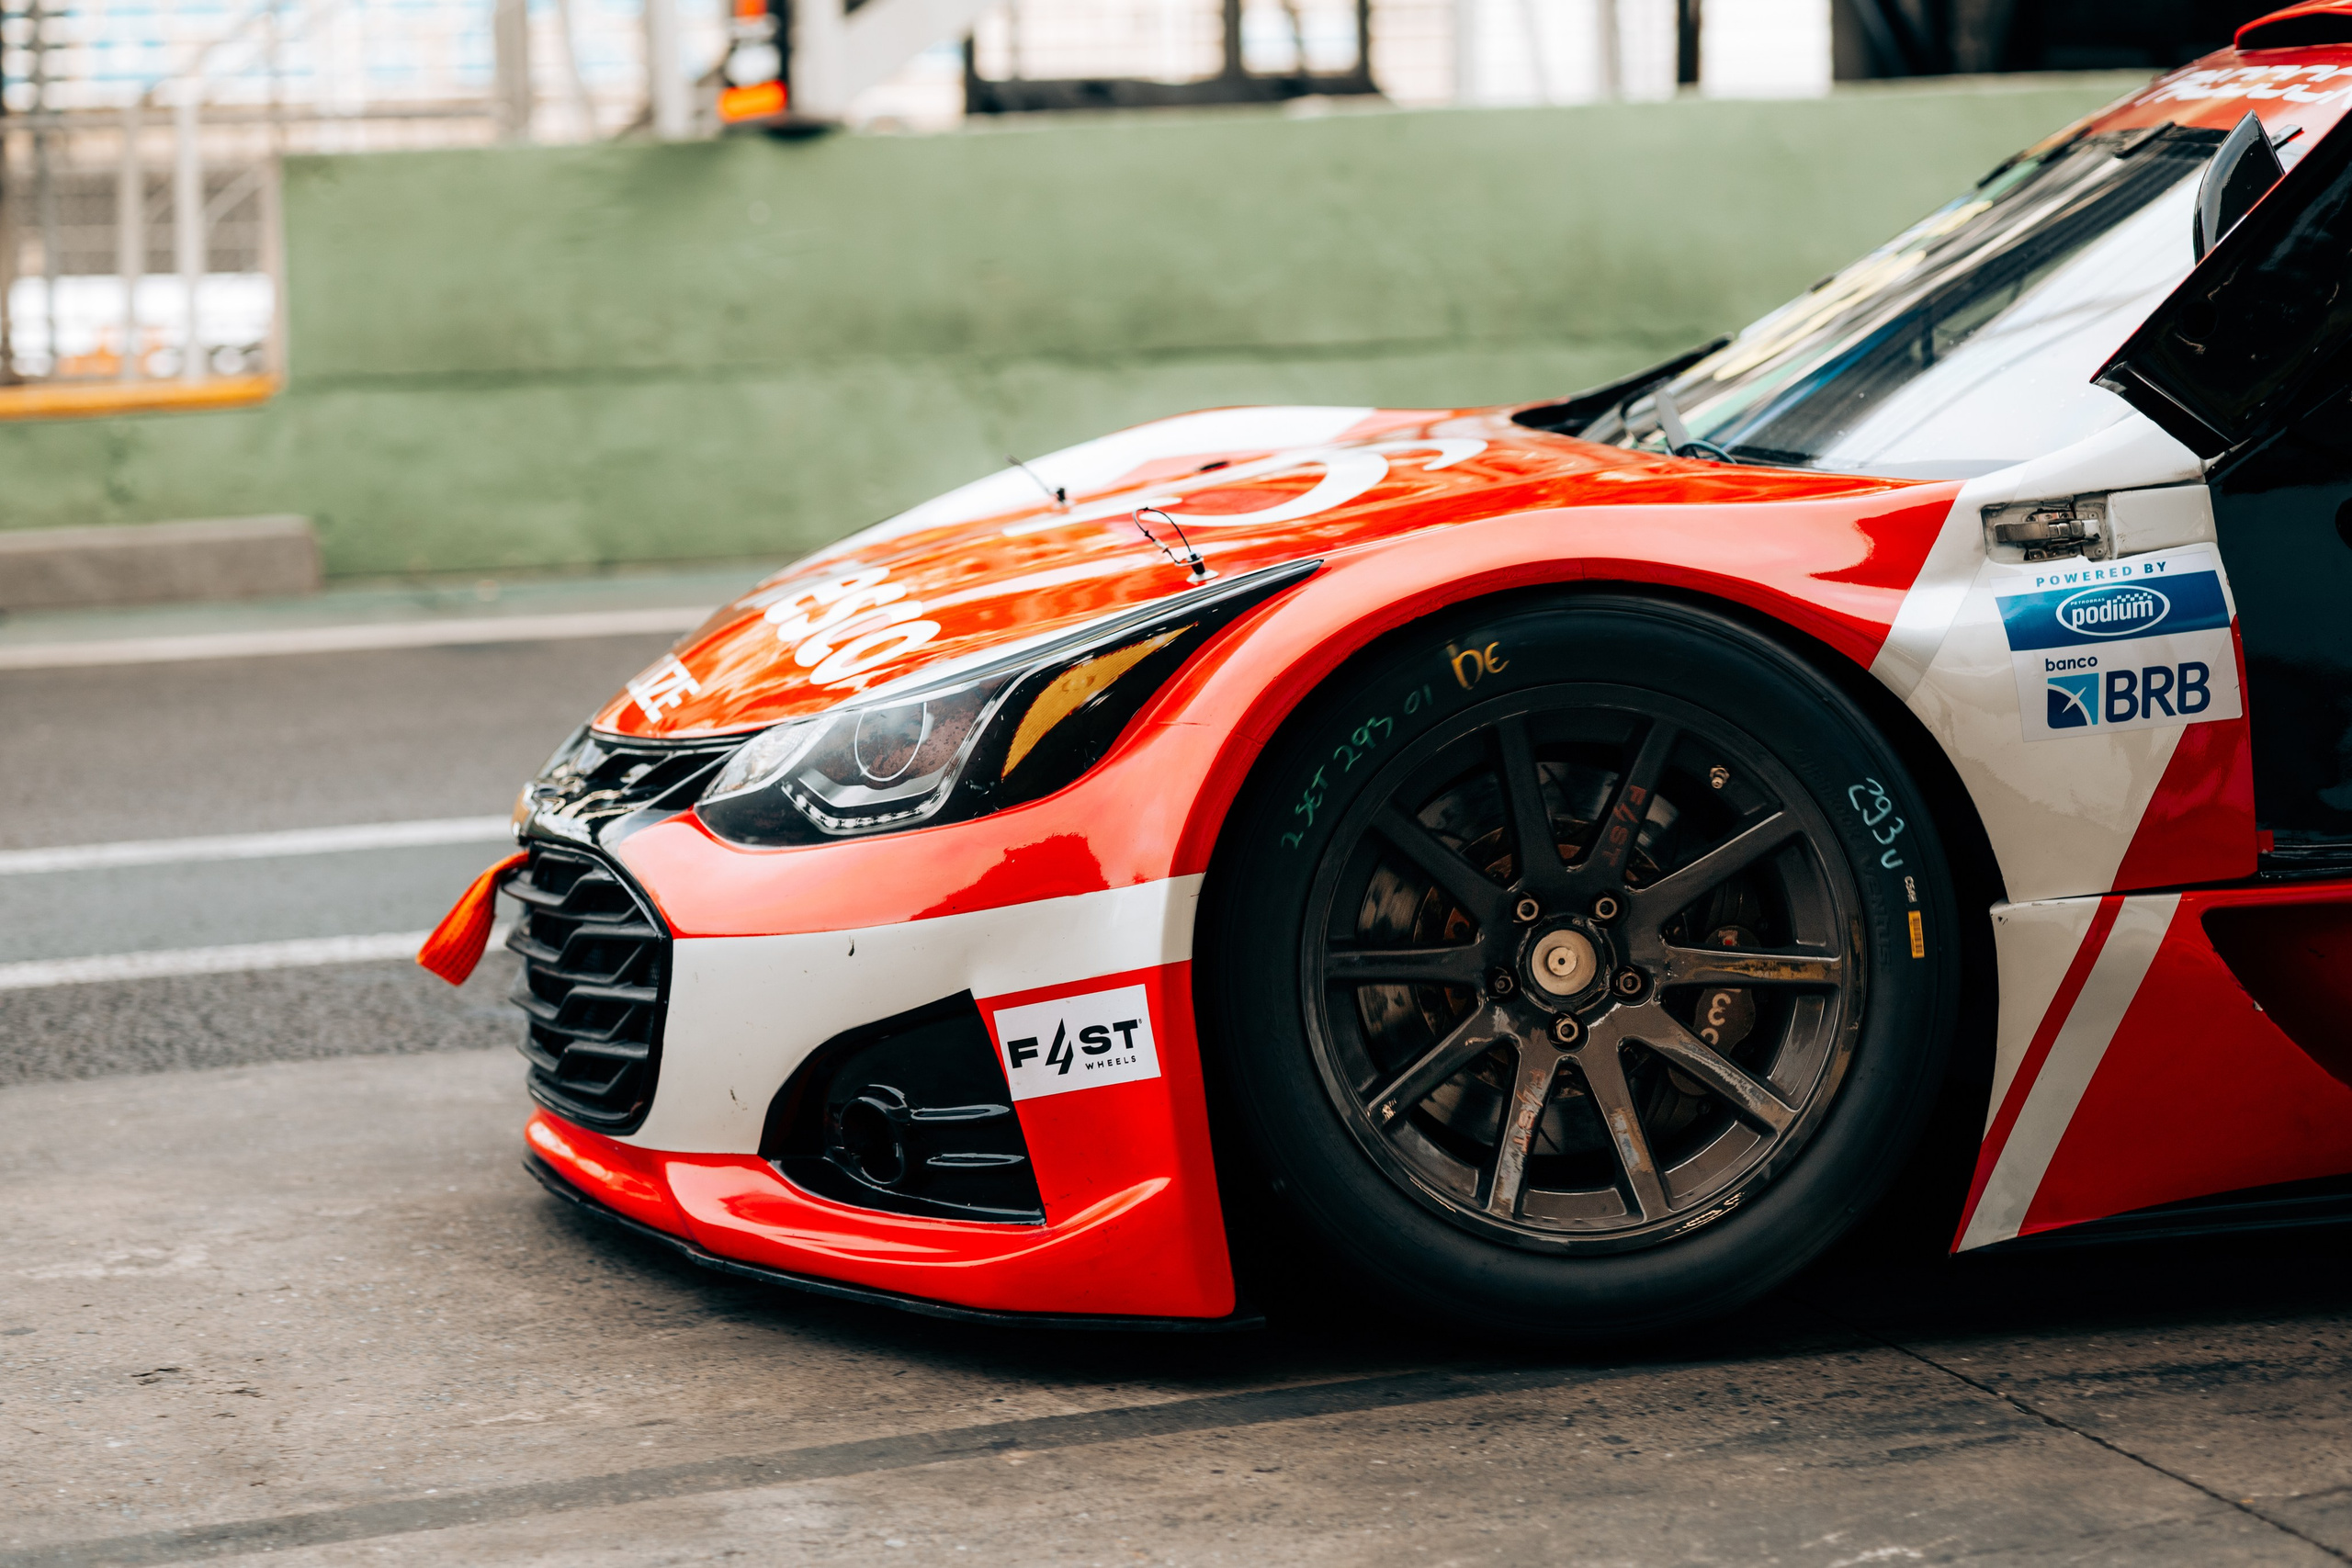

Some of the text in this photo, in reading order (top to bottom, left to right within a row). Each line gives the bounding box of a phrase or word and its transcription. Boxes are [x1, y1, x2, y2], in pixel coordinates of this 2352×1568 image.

[2036, 561, 2166, 587] POWERED BY
[2070, 597, 2105, 606] PETROBRAS
[2072, 598, 2154, 629] podium
[2045, 656, 2098, 671] banco
[2105, 661, 2211, 723] BRB
[1333, 716, 1393, 772] 293
[1085, 1055, 1137, 1070] WHEELS
